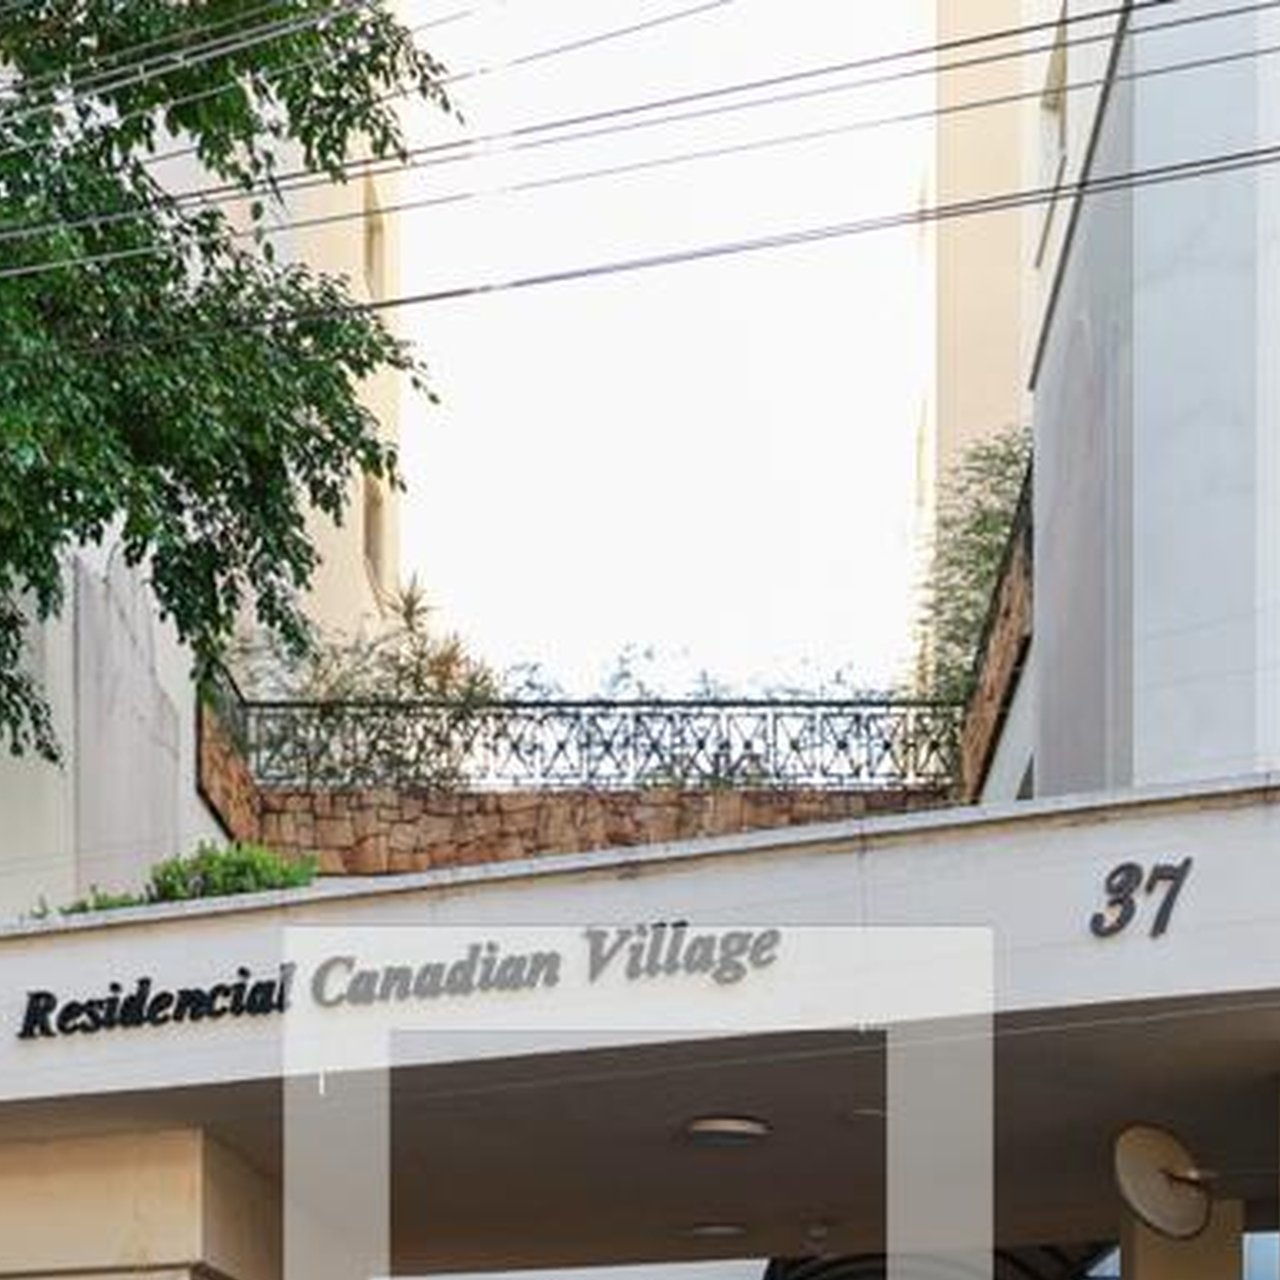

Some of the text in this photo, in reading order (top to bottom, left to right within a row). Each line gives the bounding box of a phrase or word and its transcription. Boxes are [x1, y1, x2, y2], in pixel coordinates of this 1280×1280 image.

[1090, 856, 1193, 938] 37
[17, 919, 782, 1039] Residencial Canadian Village
